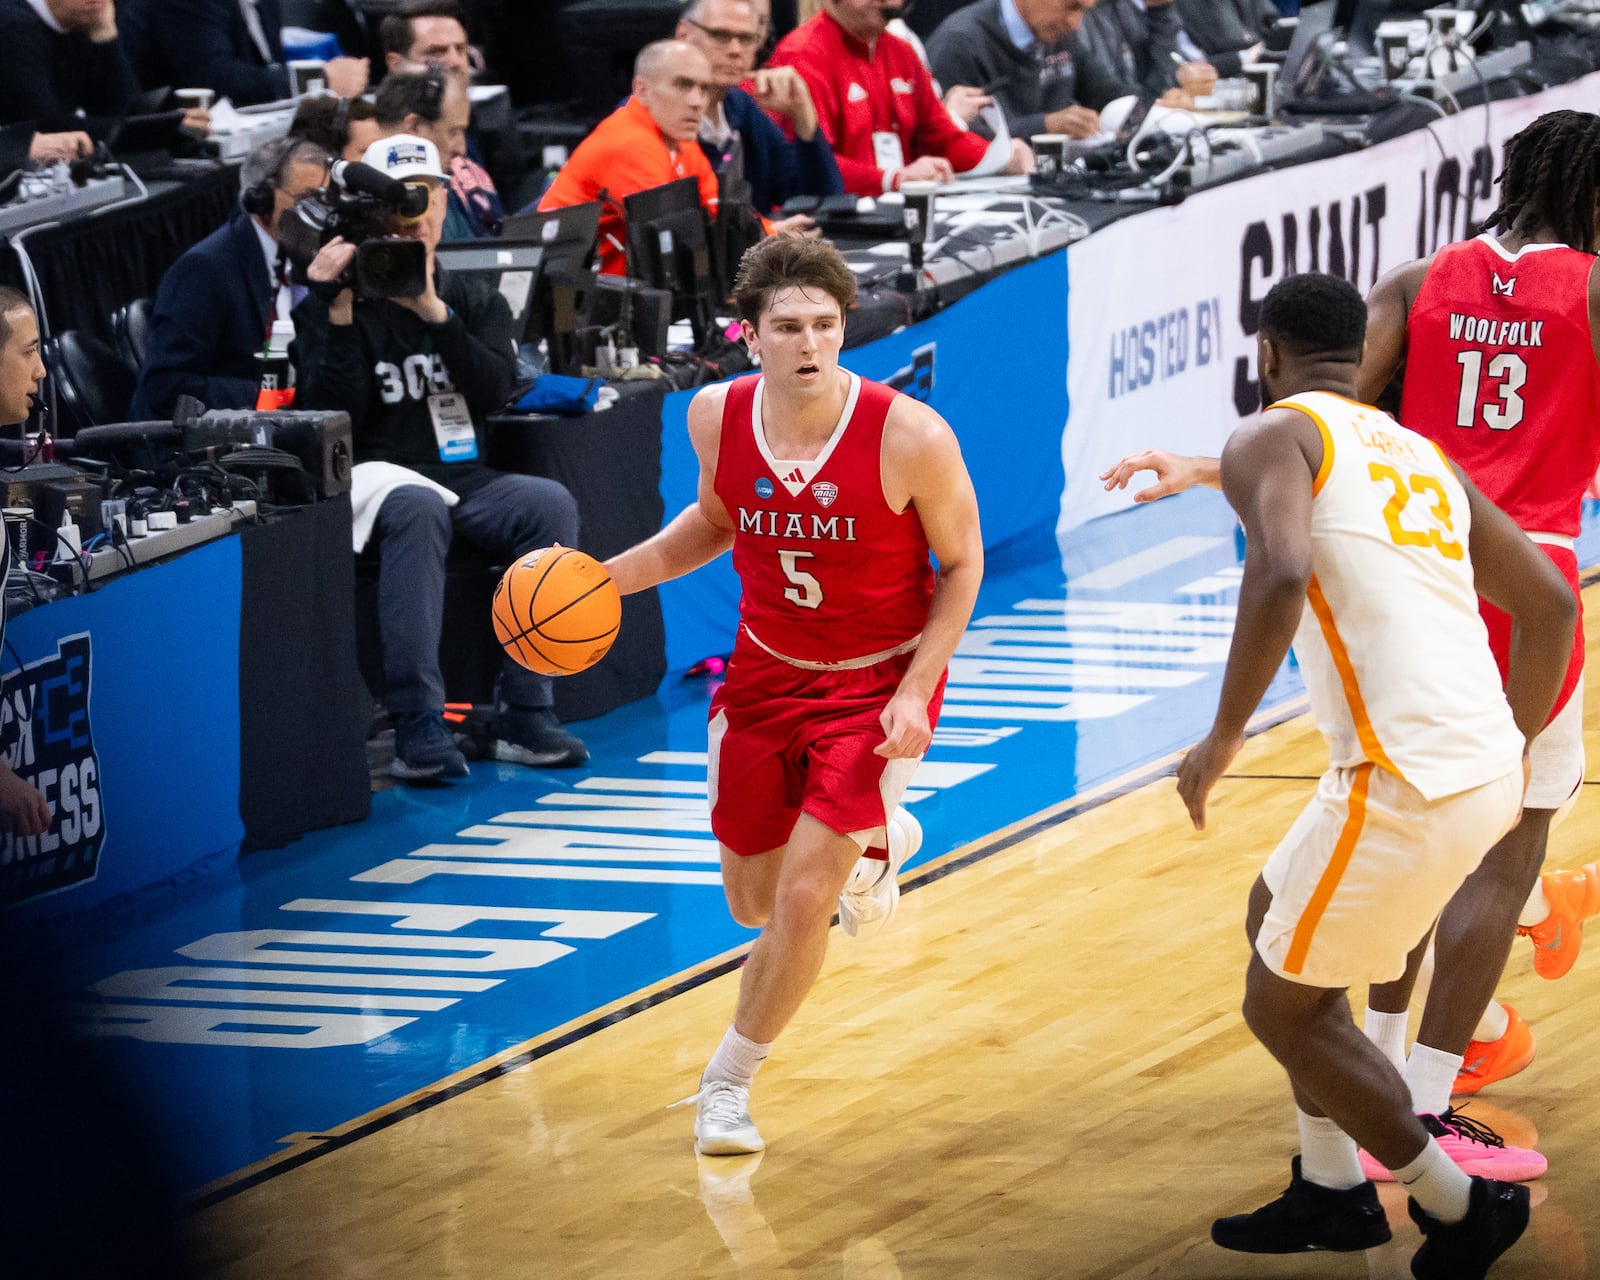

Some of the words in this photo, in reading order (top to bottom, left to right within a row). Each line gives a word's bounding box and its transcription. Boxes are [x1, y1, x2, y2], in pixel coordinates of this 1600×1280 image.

[1492, 272, 1517, 296] M
[1108, 306, 1188, 399] HOSTED
[1450, 312, 1544, 346] WOOLFOLK
[1456, 349, 1528, 431] 13
[757, 486, 773, 495] NCAA
[1367, 461, 1465, 562] 23
[738, 506, 857, 541] MIAMI
[777, 549, 824, 610] 5
